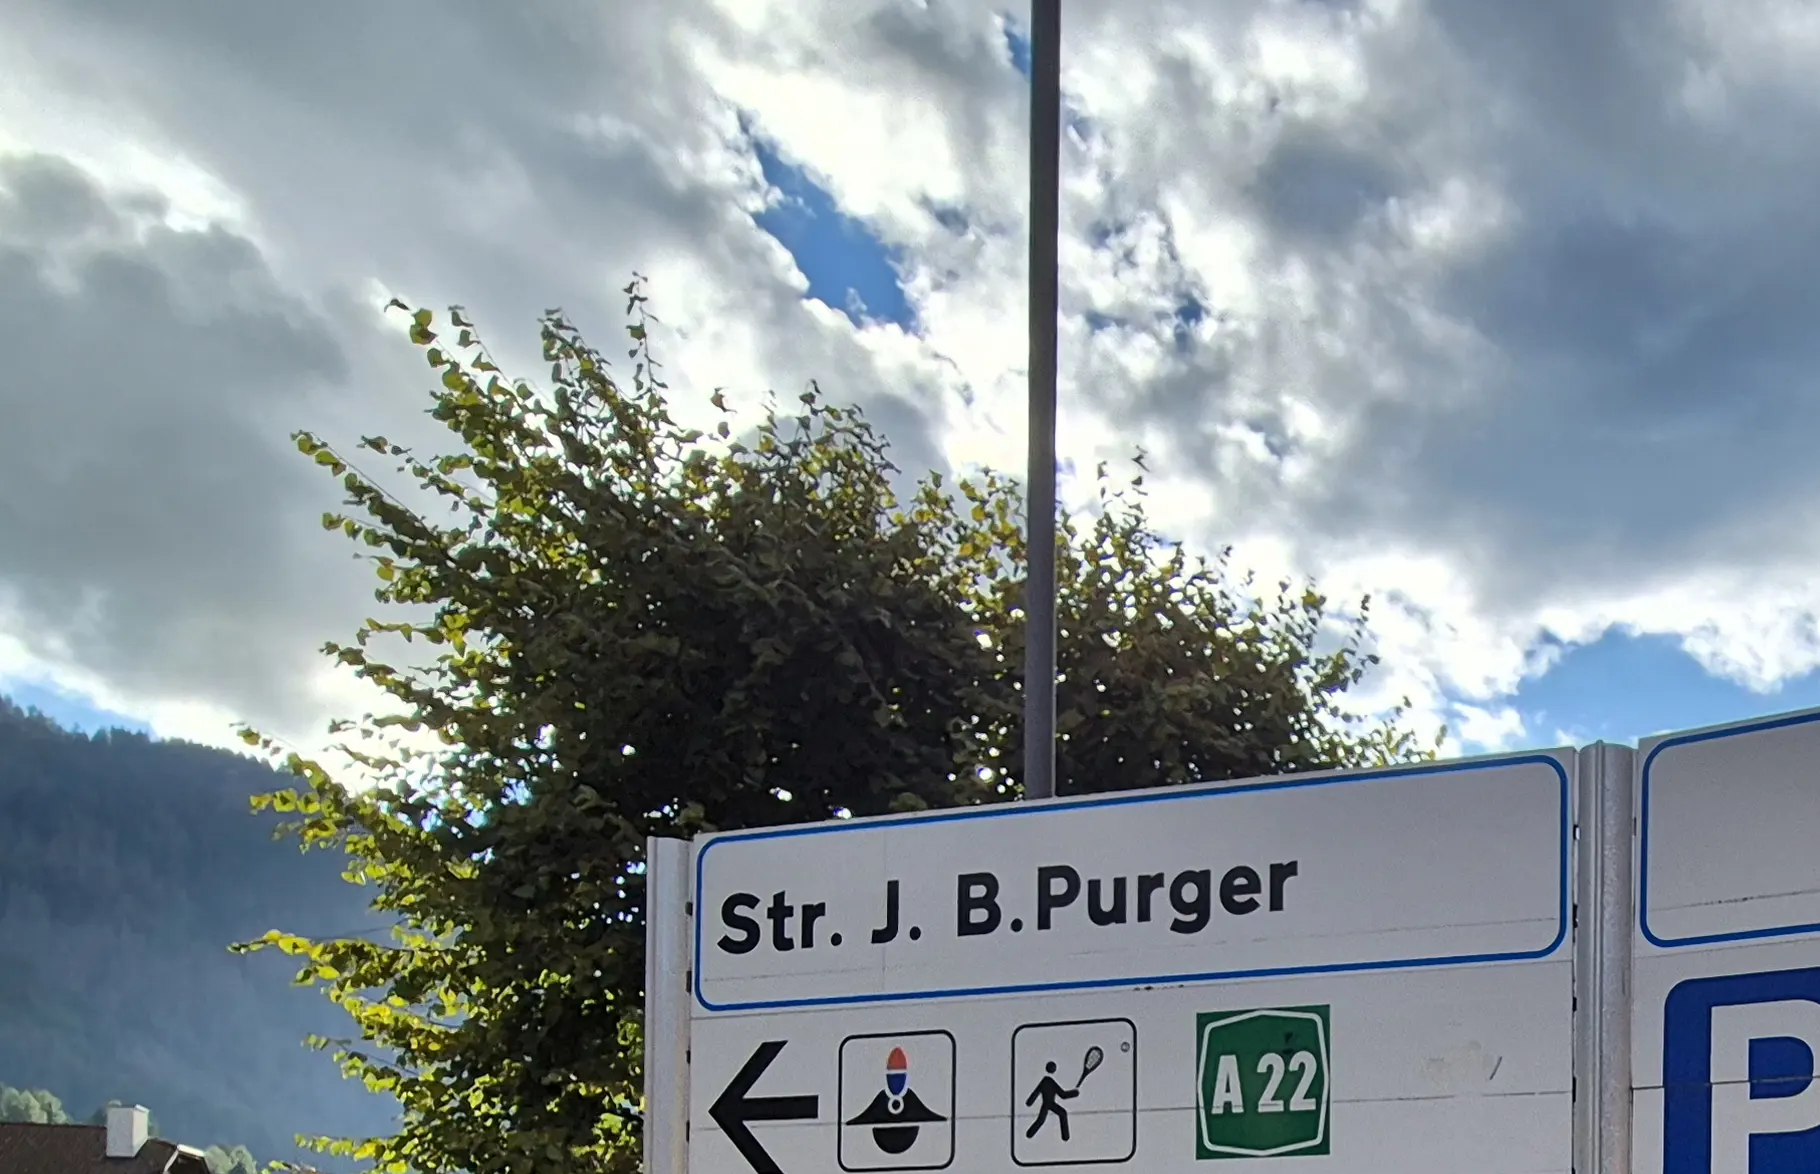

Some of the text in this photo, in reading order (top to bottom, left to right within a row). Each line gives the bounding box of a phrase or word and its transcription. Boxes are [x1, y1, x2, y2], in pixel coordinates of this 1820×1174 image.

[717, 891, 842, 954] Str.
[871, 880, 921, 944] J.
[1212, 1051, 1316, 1114] A 22
